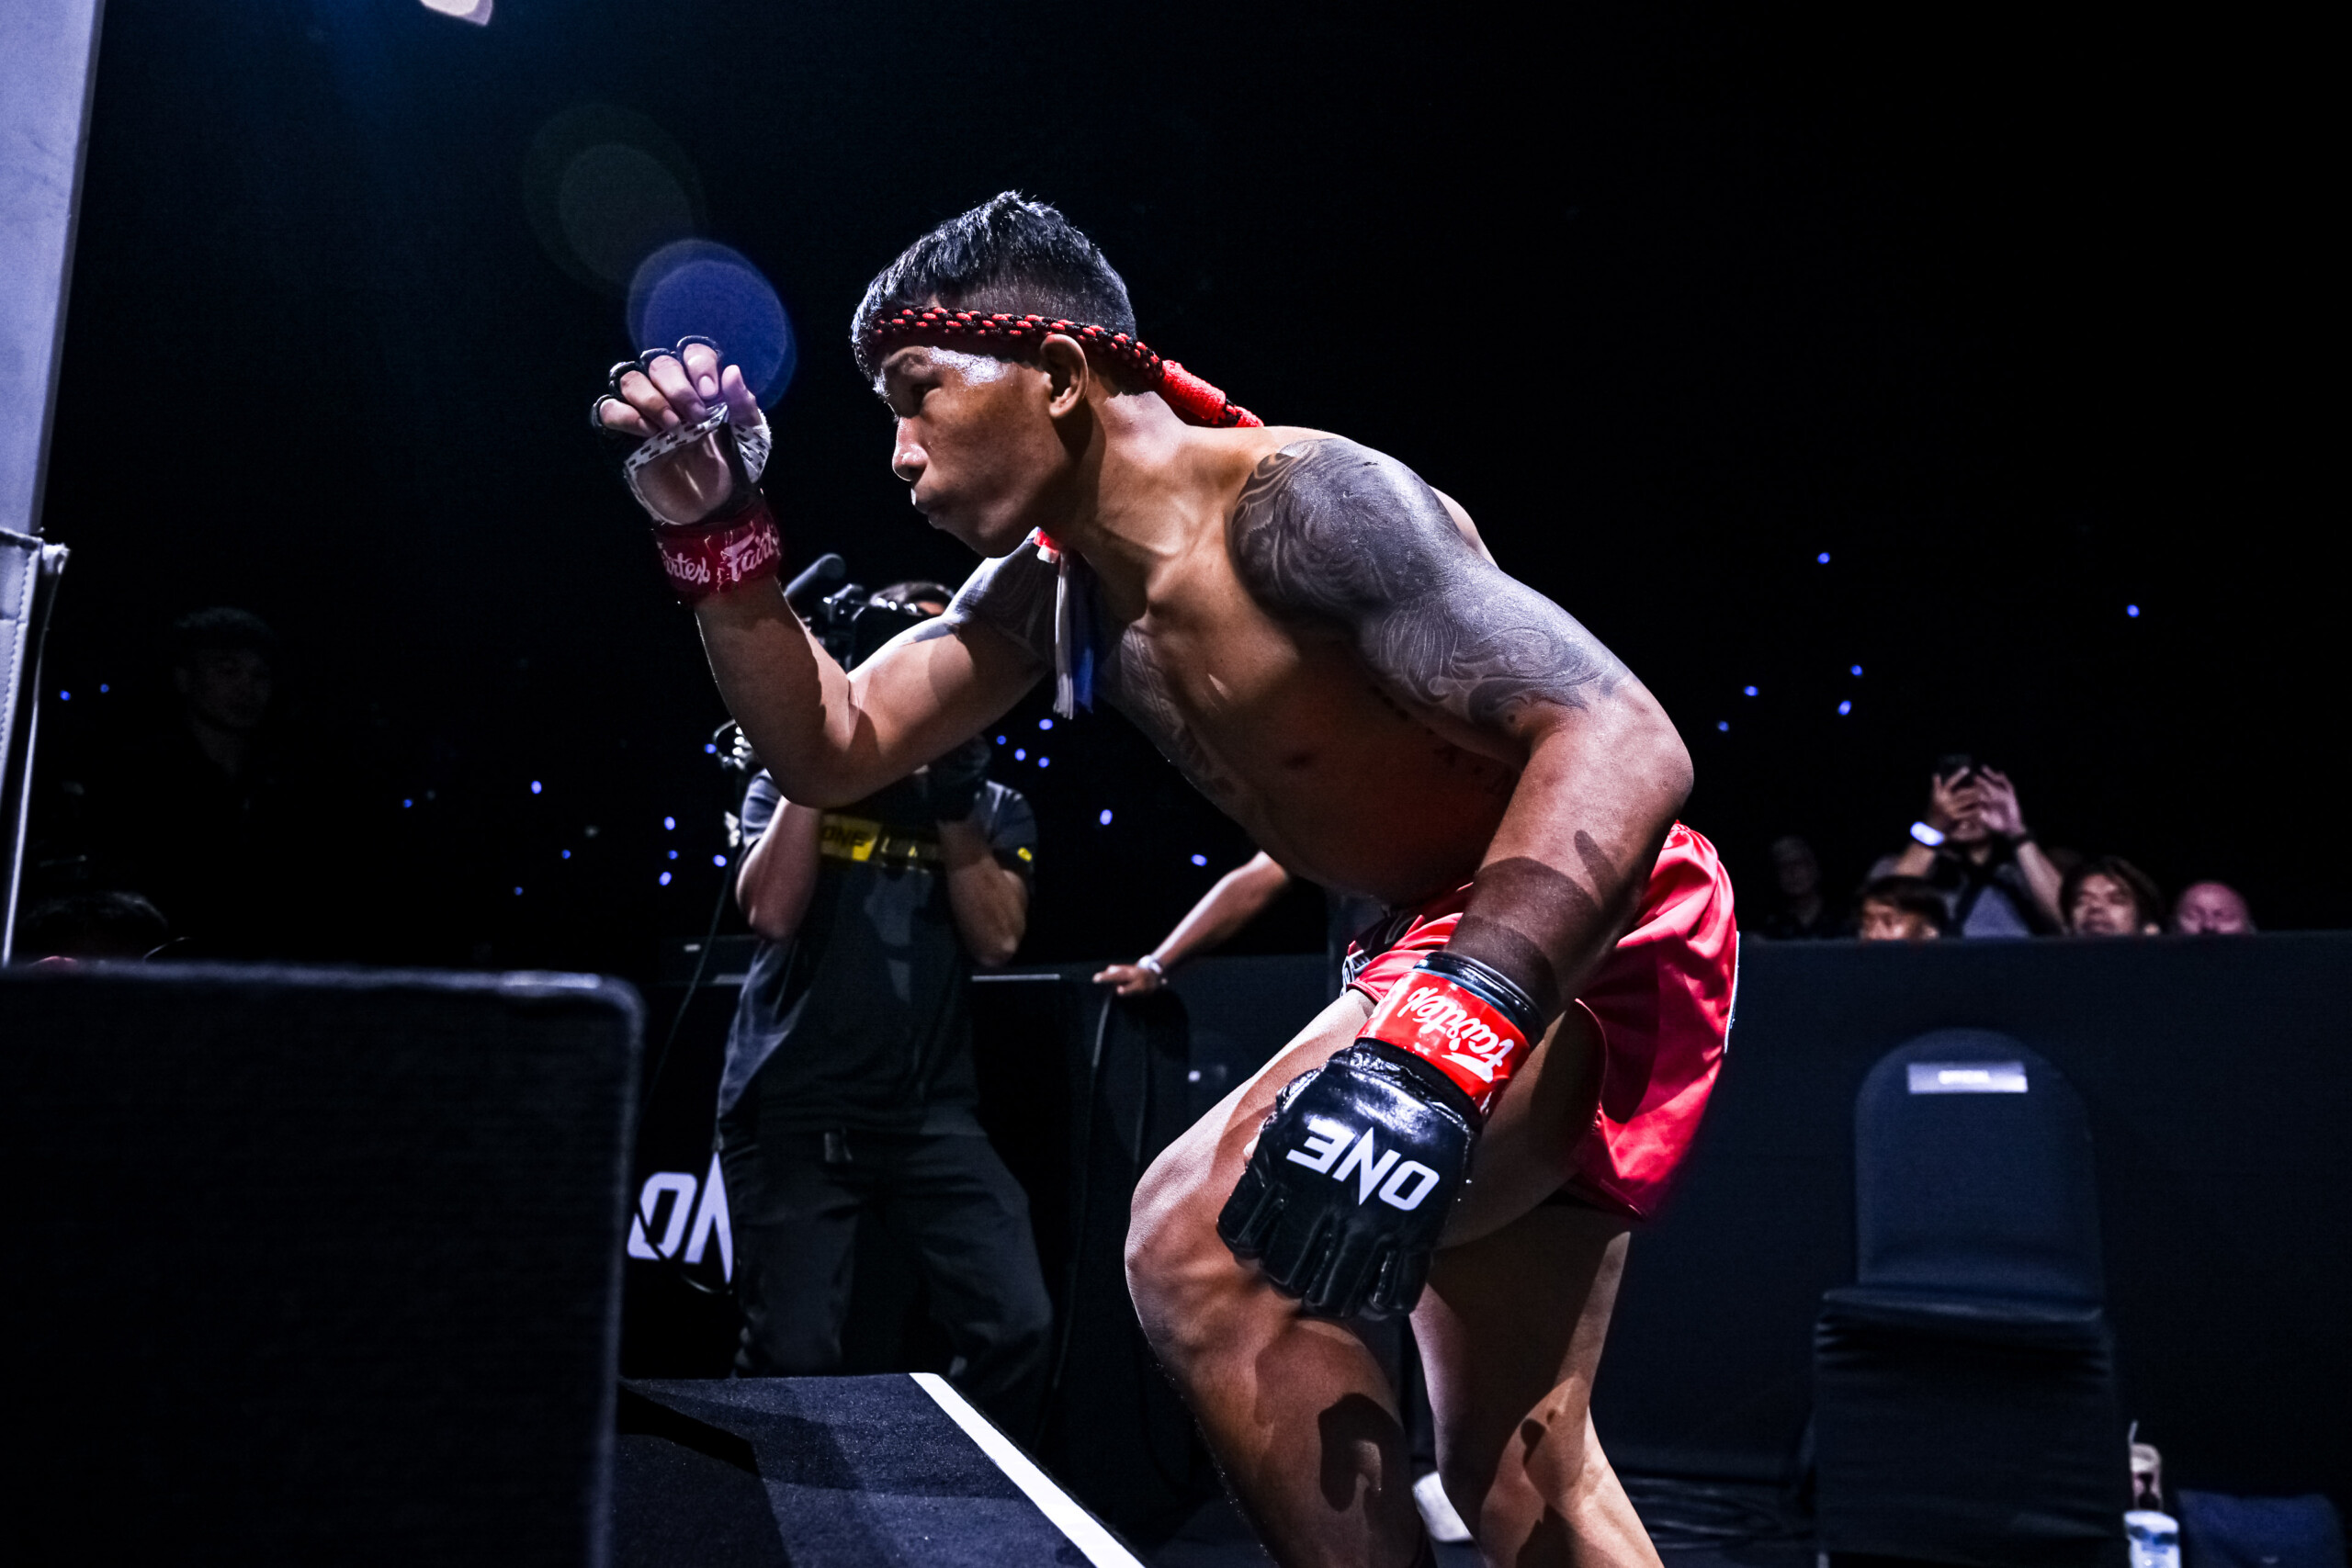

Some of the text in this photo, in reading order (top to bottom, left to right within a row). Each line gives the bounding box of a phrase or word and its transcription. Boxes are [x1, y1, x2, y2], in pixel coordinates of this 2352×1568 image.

[721, 525, 781, 582] Fairt
[1397, 987, 1515, 1084] Fairtex
[1286, 1120, 1441, 1212] ONE
[627, 1151, 734, 1284] ON
